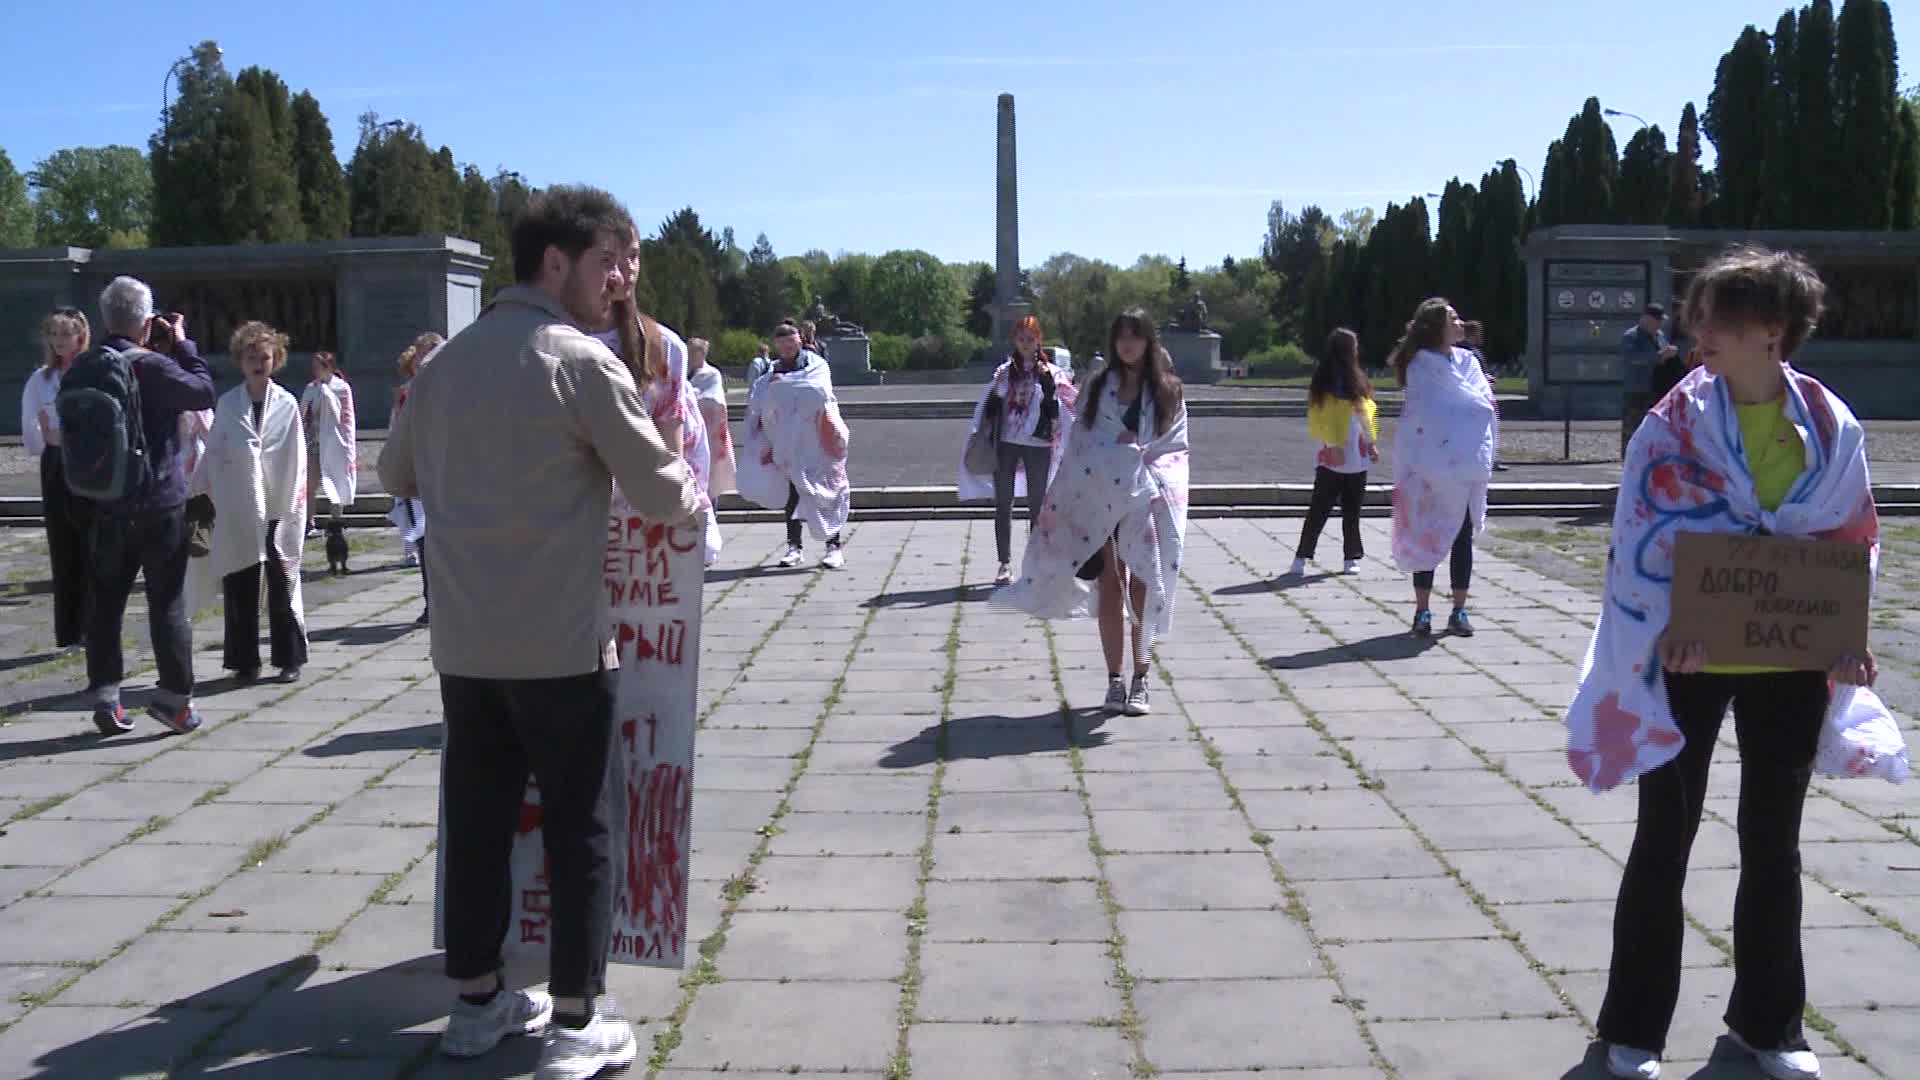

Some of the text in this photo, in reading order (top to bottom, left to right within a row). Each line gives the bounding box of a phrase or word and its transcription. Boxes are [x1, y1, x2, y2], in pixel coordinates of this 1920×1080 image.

[603, 548, 668, 578] ЕТИ
[1701, 567, 1778, 594] ДОБРО
[617, 618, 687, 664] РЫЙ
[1744, 620, 1810, 650] ВАС
